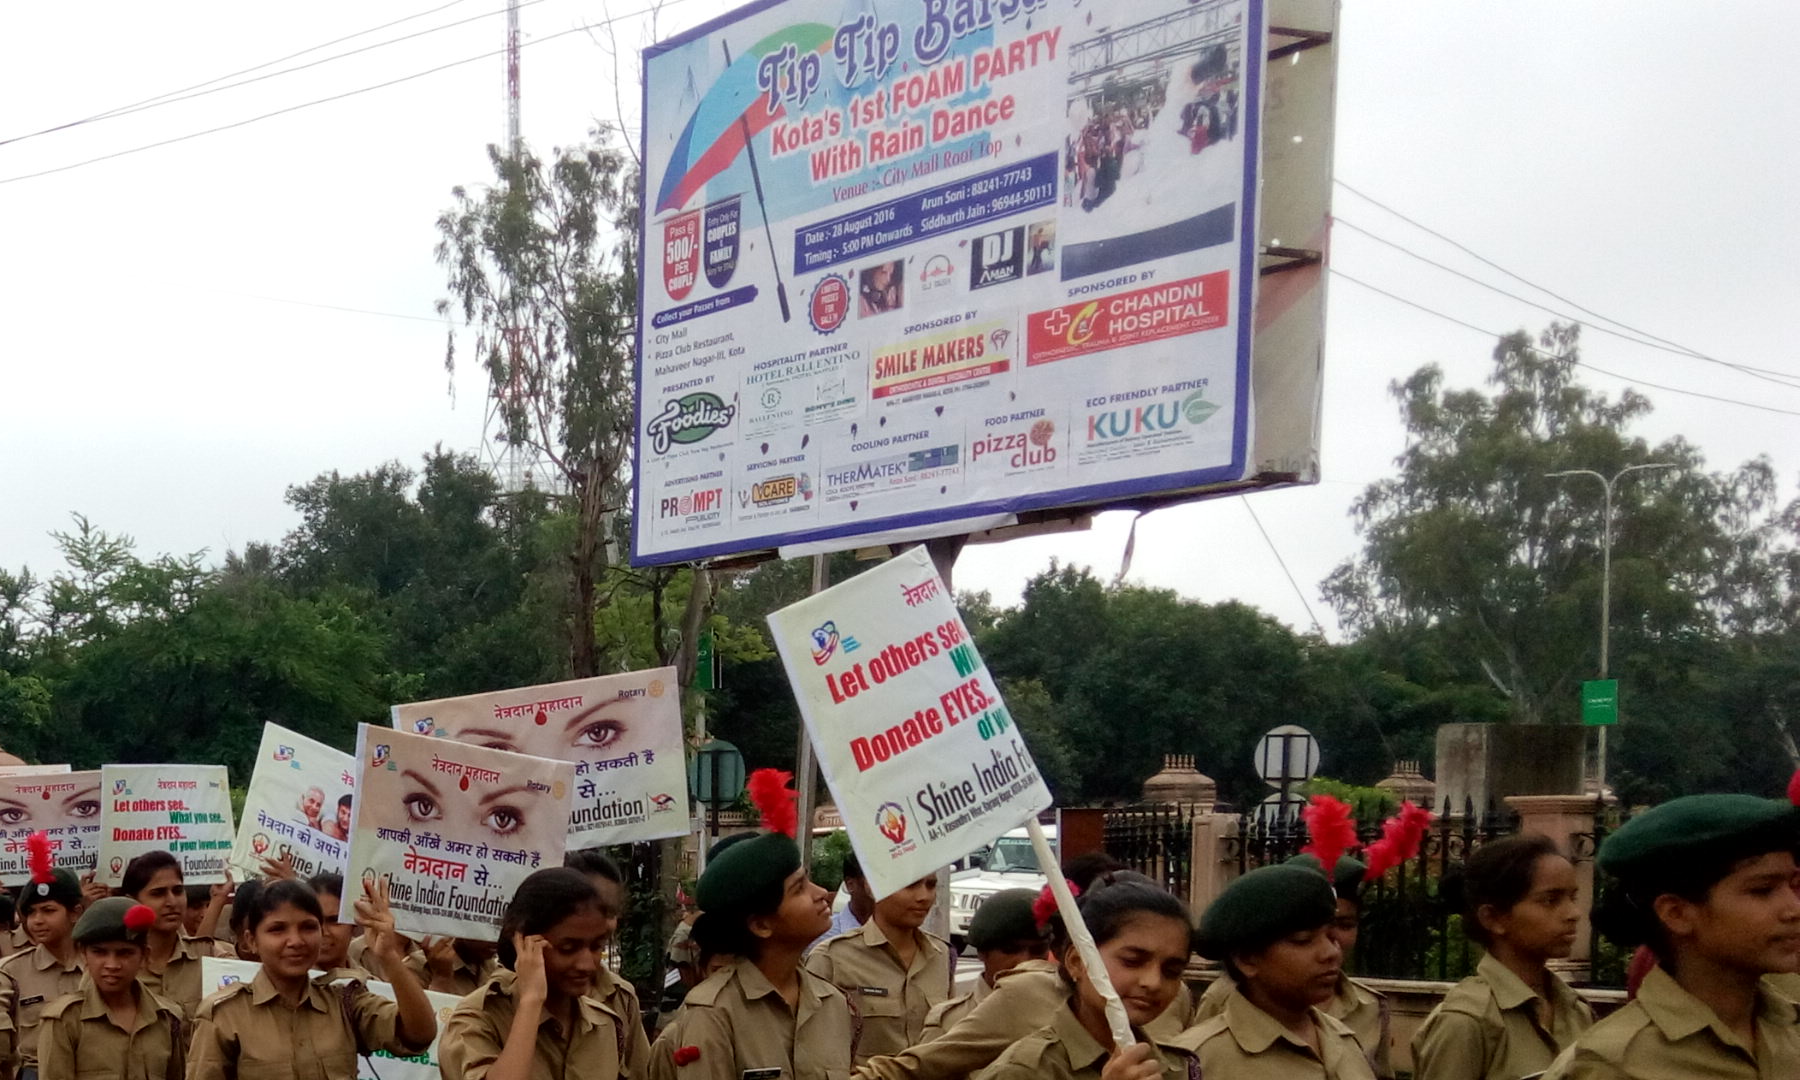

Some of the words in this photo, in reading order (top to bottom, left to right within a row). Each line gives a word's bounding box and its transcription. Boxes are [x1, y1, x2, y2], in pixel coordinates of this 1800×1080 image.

[758, 46, 820, 113] Tip
[834, 16, 899, 86] Tip
[771, 109, 841, 156] Kota's
[850, 95, 885, 128] 1st
[893, 61, 963, 112] FOAM
[974, 26, 1062, 87] PARTY
[811, 140, 862, 181] With
[869, 122, 924, 163] Rain
[932, 95, 1015, 142] Dance
[832, 181, 869, 202] Venue
[883, 167, 907, 188] City
[911, 154, 938, 175] Mall
[943, 147, 974, 169] Roof
[978, 139, 1002, 161] Top
[921, 195, 944, 211] Arun
[945, 187, 966, 205] Soni
[670, 225, 686, 237] Pass
[805, 230, 825, 246] Date
[832, 224, 843, 238] 28
[844, 216, 873, 236] August
[874, 208, 895, 226] 2016
[921, 207, 966, 232] Siddharth
[966, 203, 986, 221] Jain
[707, 221, 737, 243] COUPLES
[805, 247, 832, 266] Timing
[860, 234, 874, 249] PM
[875, 224, 913, 246] Onwards
[667, 235, 698, 264] 500/-
[675, 262, 689, 275] PER
[668, 273, 693, 292] COUPLE
[1068, 275, 1136, 297] SPONSORED
[1141, 270, 1156, 281] BY
[657, 310, 677, 324] Collect
[679, 306, 693, 319] your
[694, 300, 714, 313] Passes
[1110, 281, 1203, 316] CHANDNI
[904, 316, 962, 336] SPONSORED
[965, 310, 978, 321] BY
[1109, 301, 1209, 335] HOSPITAL
[656, 332, 669, 345] City
[671, 327, 688, 341] Mall
[655, 347, 673, 361] Pizza
[675, 343, 692, 356] Club
[655, 360, 691, 377] Mahaveer
[728, 346, 745, 358] Kota
[754, 352, 806, 371] HOSPITALITY
[809, 342, 848, 358] PARTNER
[875, 349, 918, 380] SMILE
[922, 334, 985, 370] MAKERS
[663, 379, 702, 394] PRESENTED
[703, 375, 715, 386] BY
[746, 370, 784, 385] HOTEL
[1086, 397, 1107, 408] ECO
[1110, 387, 1159, 404] FRIENDLY
[1162, 378, 1209, 394] PARTNER
[985, 414, 1007, 427] FOOD
[1010, 408, 1045, 423] PARTNER
[1088, 400, 1180, 441] KUKU
[851, 437, 890, 452] COOLING
[892, 430, 929, 445] PARTNER
[972, 432, 1027, 462] pizza
[779, 454, 805, 465] PARTNER
[1011, 442, 1056, 468] club
[700, 470, 723, 482] PARTNER
[901, 577, 939, 608] नेत्रदान
[826, 662, 869, 705] Let
[870, 632, 939, 685] others
[618, 687, 646, 699] Rotary
[494, 704, 534, 721] नेत्रदान
[538, 696, 583, 714] महादान
[849, 706, 944, 772] Donate
[977, 710, 997, 742] of
[432, 754, 463, 775] नेत्रदान
[464, 766, 500, 784] महादान
[595, 752, 639, 773] सकती
[527, 779, 551, 793] Rotary
[917, 780, 976, 826] Shine
[972, 749, 1019, 797] India
[114, 799, 130, 812] Let
[132, 799, 166, 812] others
[169, 811, 192, 824] What
[194, 812, 208, 824] you
[568, 798, 643, 825] undation
[67, 825, 78, 834] हो
[113, 827, 154, 841] Donate
[258, 809, 295, 839] नेत्रदान
[297, 828, 312, 847] को
[314, 837, 341, 860] अपने
[169, 840, 178, 852] of
[179, 841, 197, 852] your
[377, 826, 411, 846] आपकी
[445, 841, 472, 856] अमर
[477, 842, 489, 861] हो
[492, 848, 528, 866] सकती
[184, 854, 224, 871] Foundation
[404, 845, 468, 883] नेत्रदान
[415, 880, 445, 907] India
